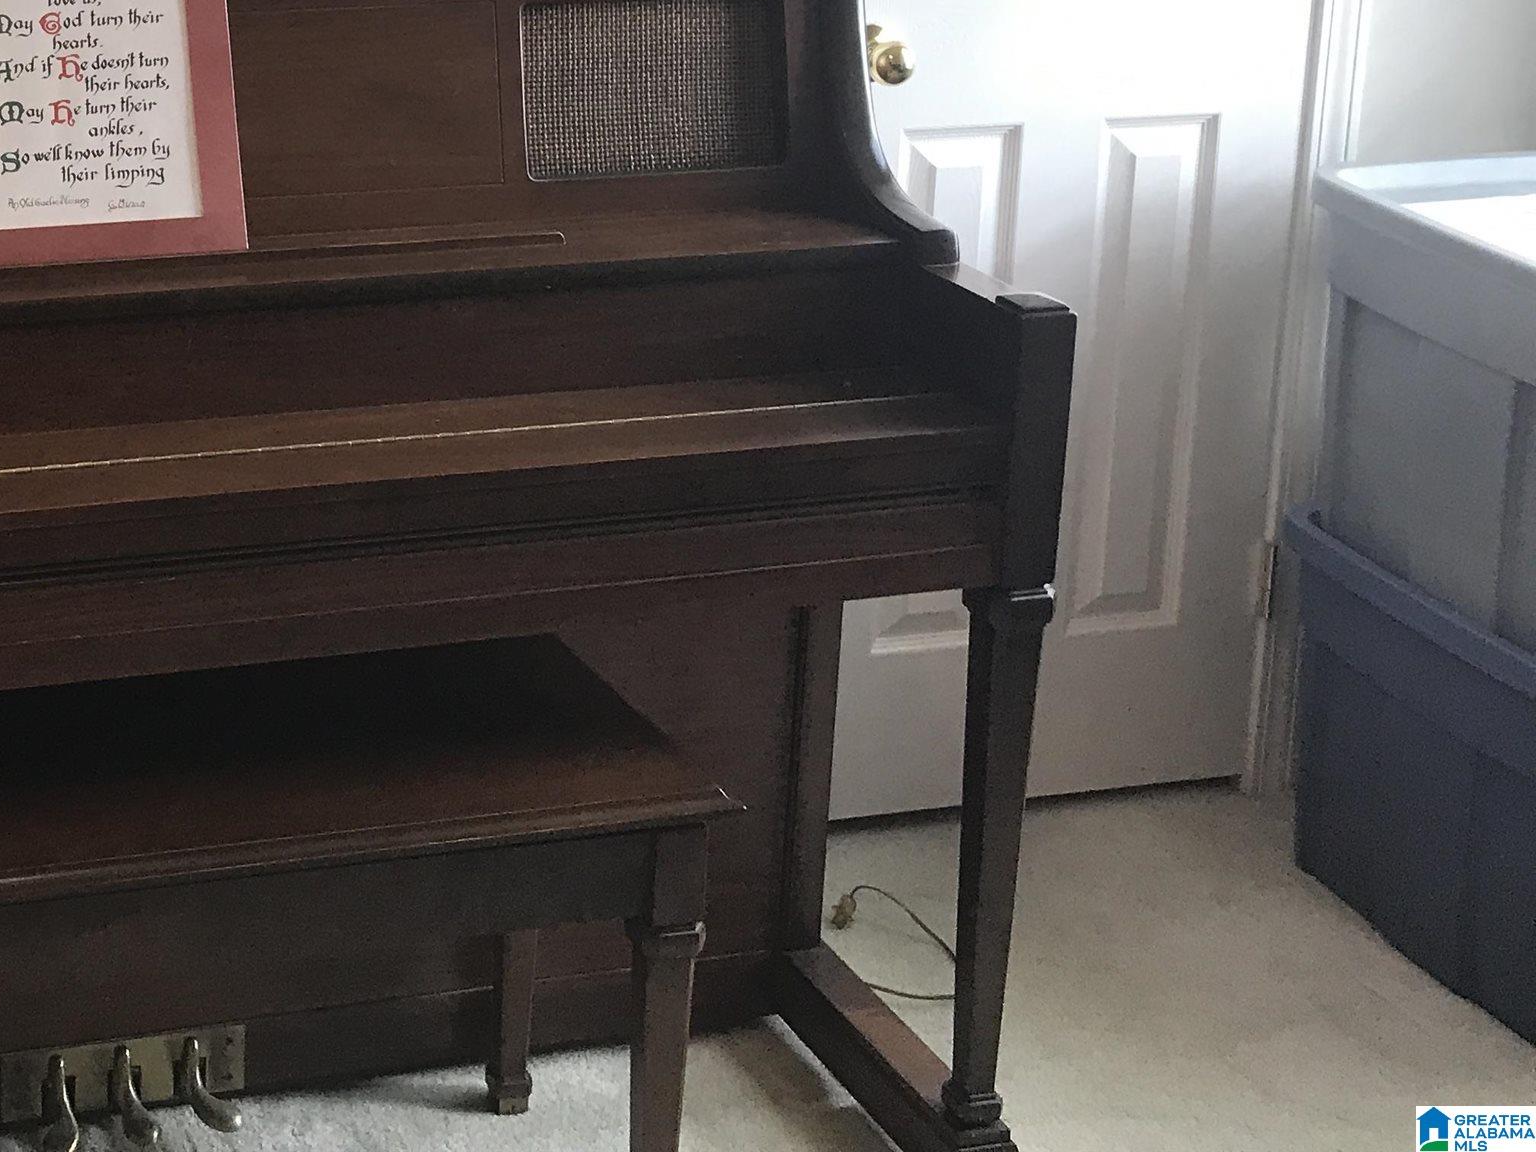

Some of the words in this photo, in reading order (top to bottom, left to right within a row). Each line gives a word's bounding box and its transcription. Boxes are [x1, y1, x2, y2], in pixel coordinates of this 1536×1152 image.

[38, 10, 85, 35] God
[90, 10, 124, 29] turn
[128, 8, 165, 30] their
[52, 32, 104, 54] hearts.
[41, 54, 56, 79] if
[56, 53, 88, 82] He
[91, 51, 136, 70] doesn't
[138, 51, 170, 69] turn
[85, 74, 120, 96] their
[124, 73, 170, 95] hearts,
[48, 99, 82, 127] He
[85, 98, 116, 118] turn
[120, 95, 158, 117] their
[0, 148, 31, 175] So
[33, 143, 62, 162] we'll
[64, 143, 105, 165] know
[109, 139, 148, 162] them
[152, 138, 171, 160] by
[61, 164, 99, 189] their
[104, 162, 166, 189] limping
